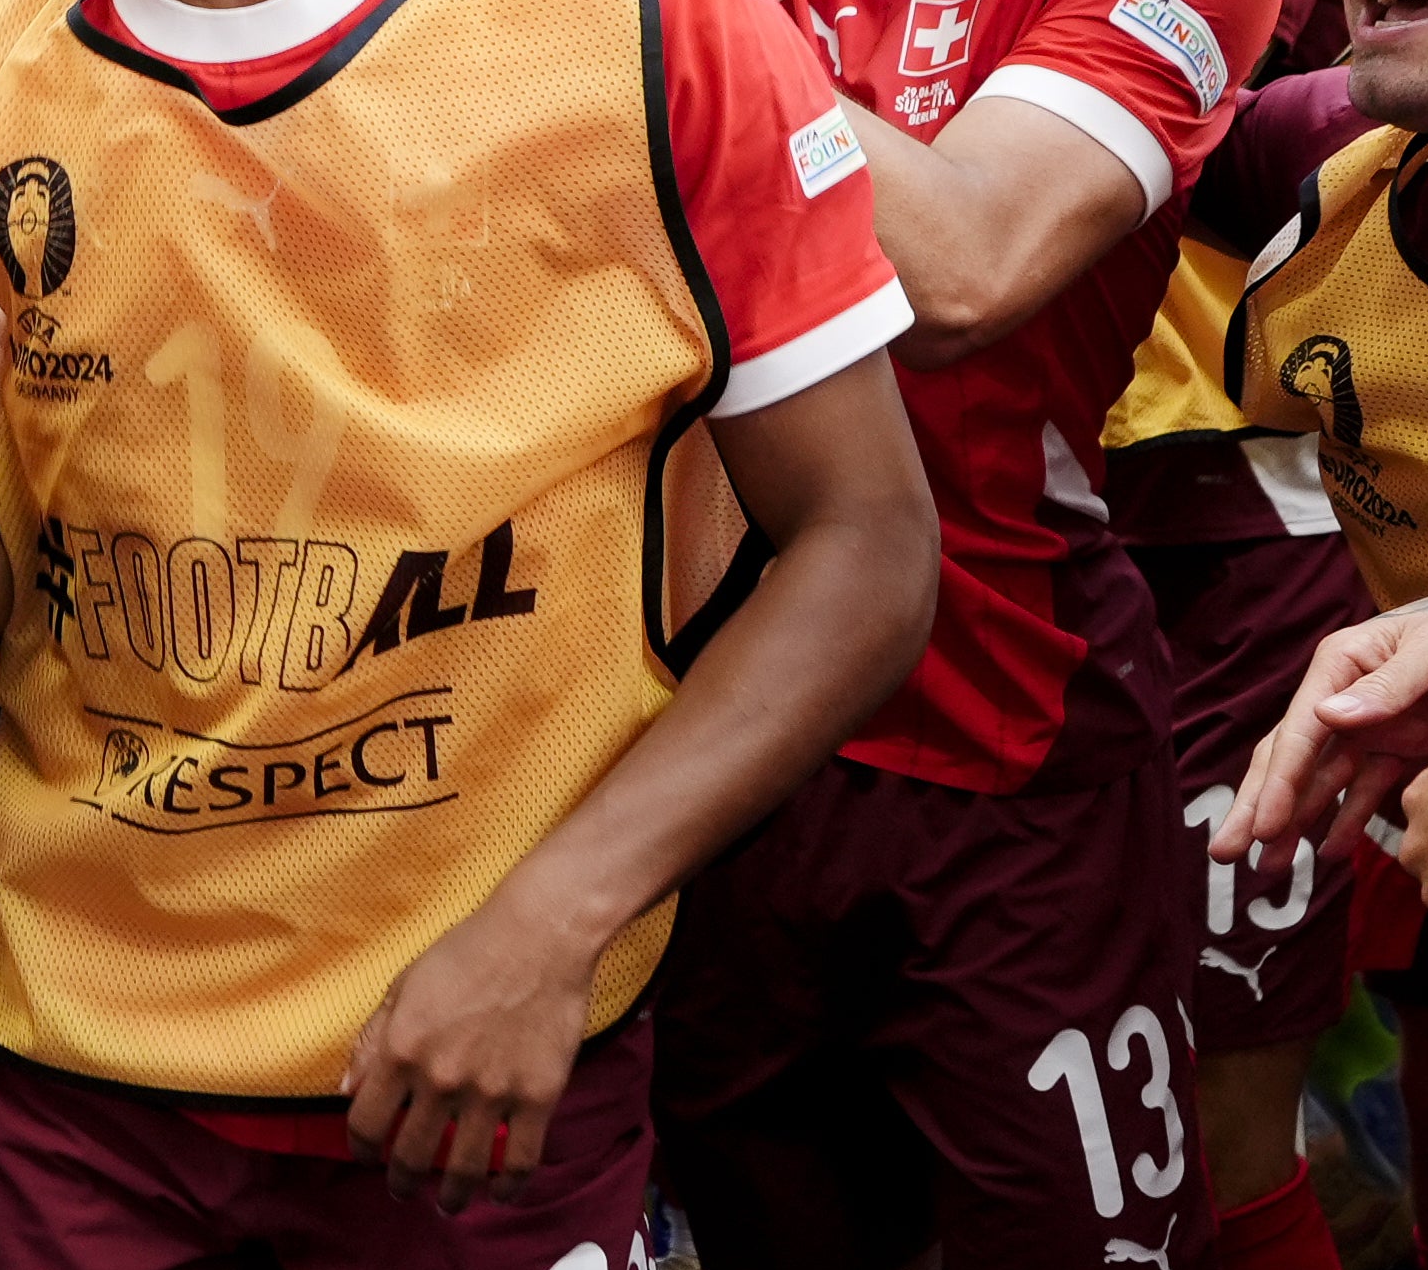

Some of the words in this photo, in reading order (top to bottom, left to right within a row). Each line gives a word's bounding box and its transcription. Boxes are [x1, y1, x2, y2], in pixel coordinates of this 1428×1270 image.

[36, 517, 539, 692] #FOOTBALL
[94, 716, 455, 815] RESPECT
[1027, 1005, 1185, 1218] 13
